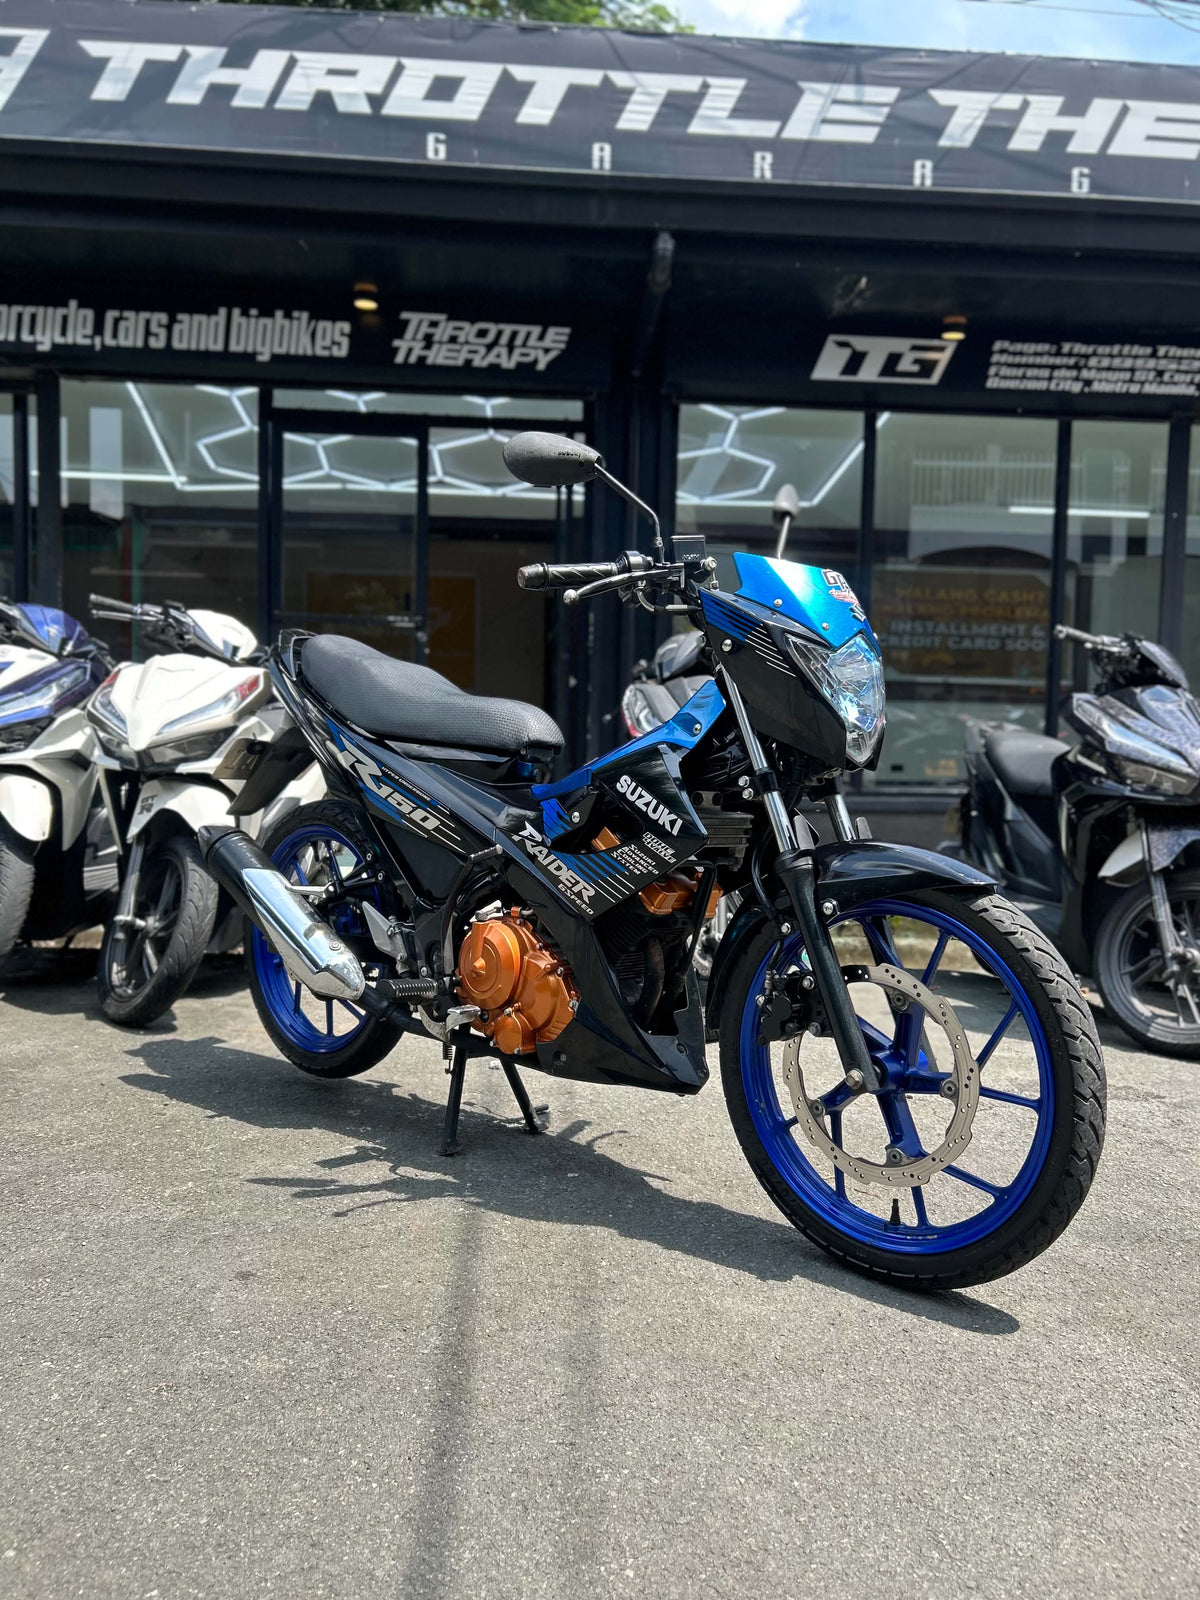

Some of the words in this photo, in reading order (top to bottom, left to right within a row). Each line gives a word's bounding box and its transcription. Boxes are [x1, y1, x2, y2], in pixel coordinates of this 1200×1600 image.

[77, 40, 901, 143] THROTTLE
[928, 88, 1200, 161] THE
[172, 306, 228, 352] and
[228, 307, 352, 362] bigbikes
[399, 311, 572, 349] THROTTLE
[392, 338, 562, 371] THERAPY
[616, 774, 683, 836] SUZUKI
[511, 820, 597, 904] RAIDER
[616, 848, 649, 874] COOLING
[621, 846, 660, 875] ADVANCED
